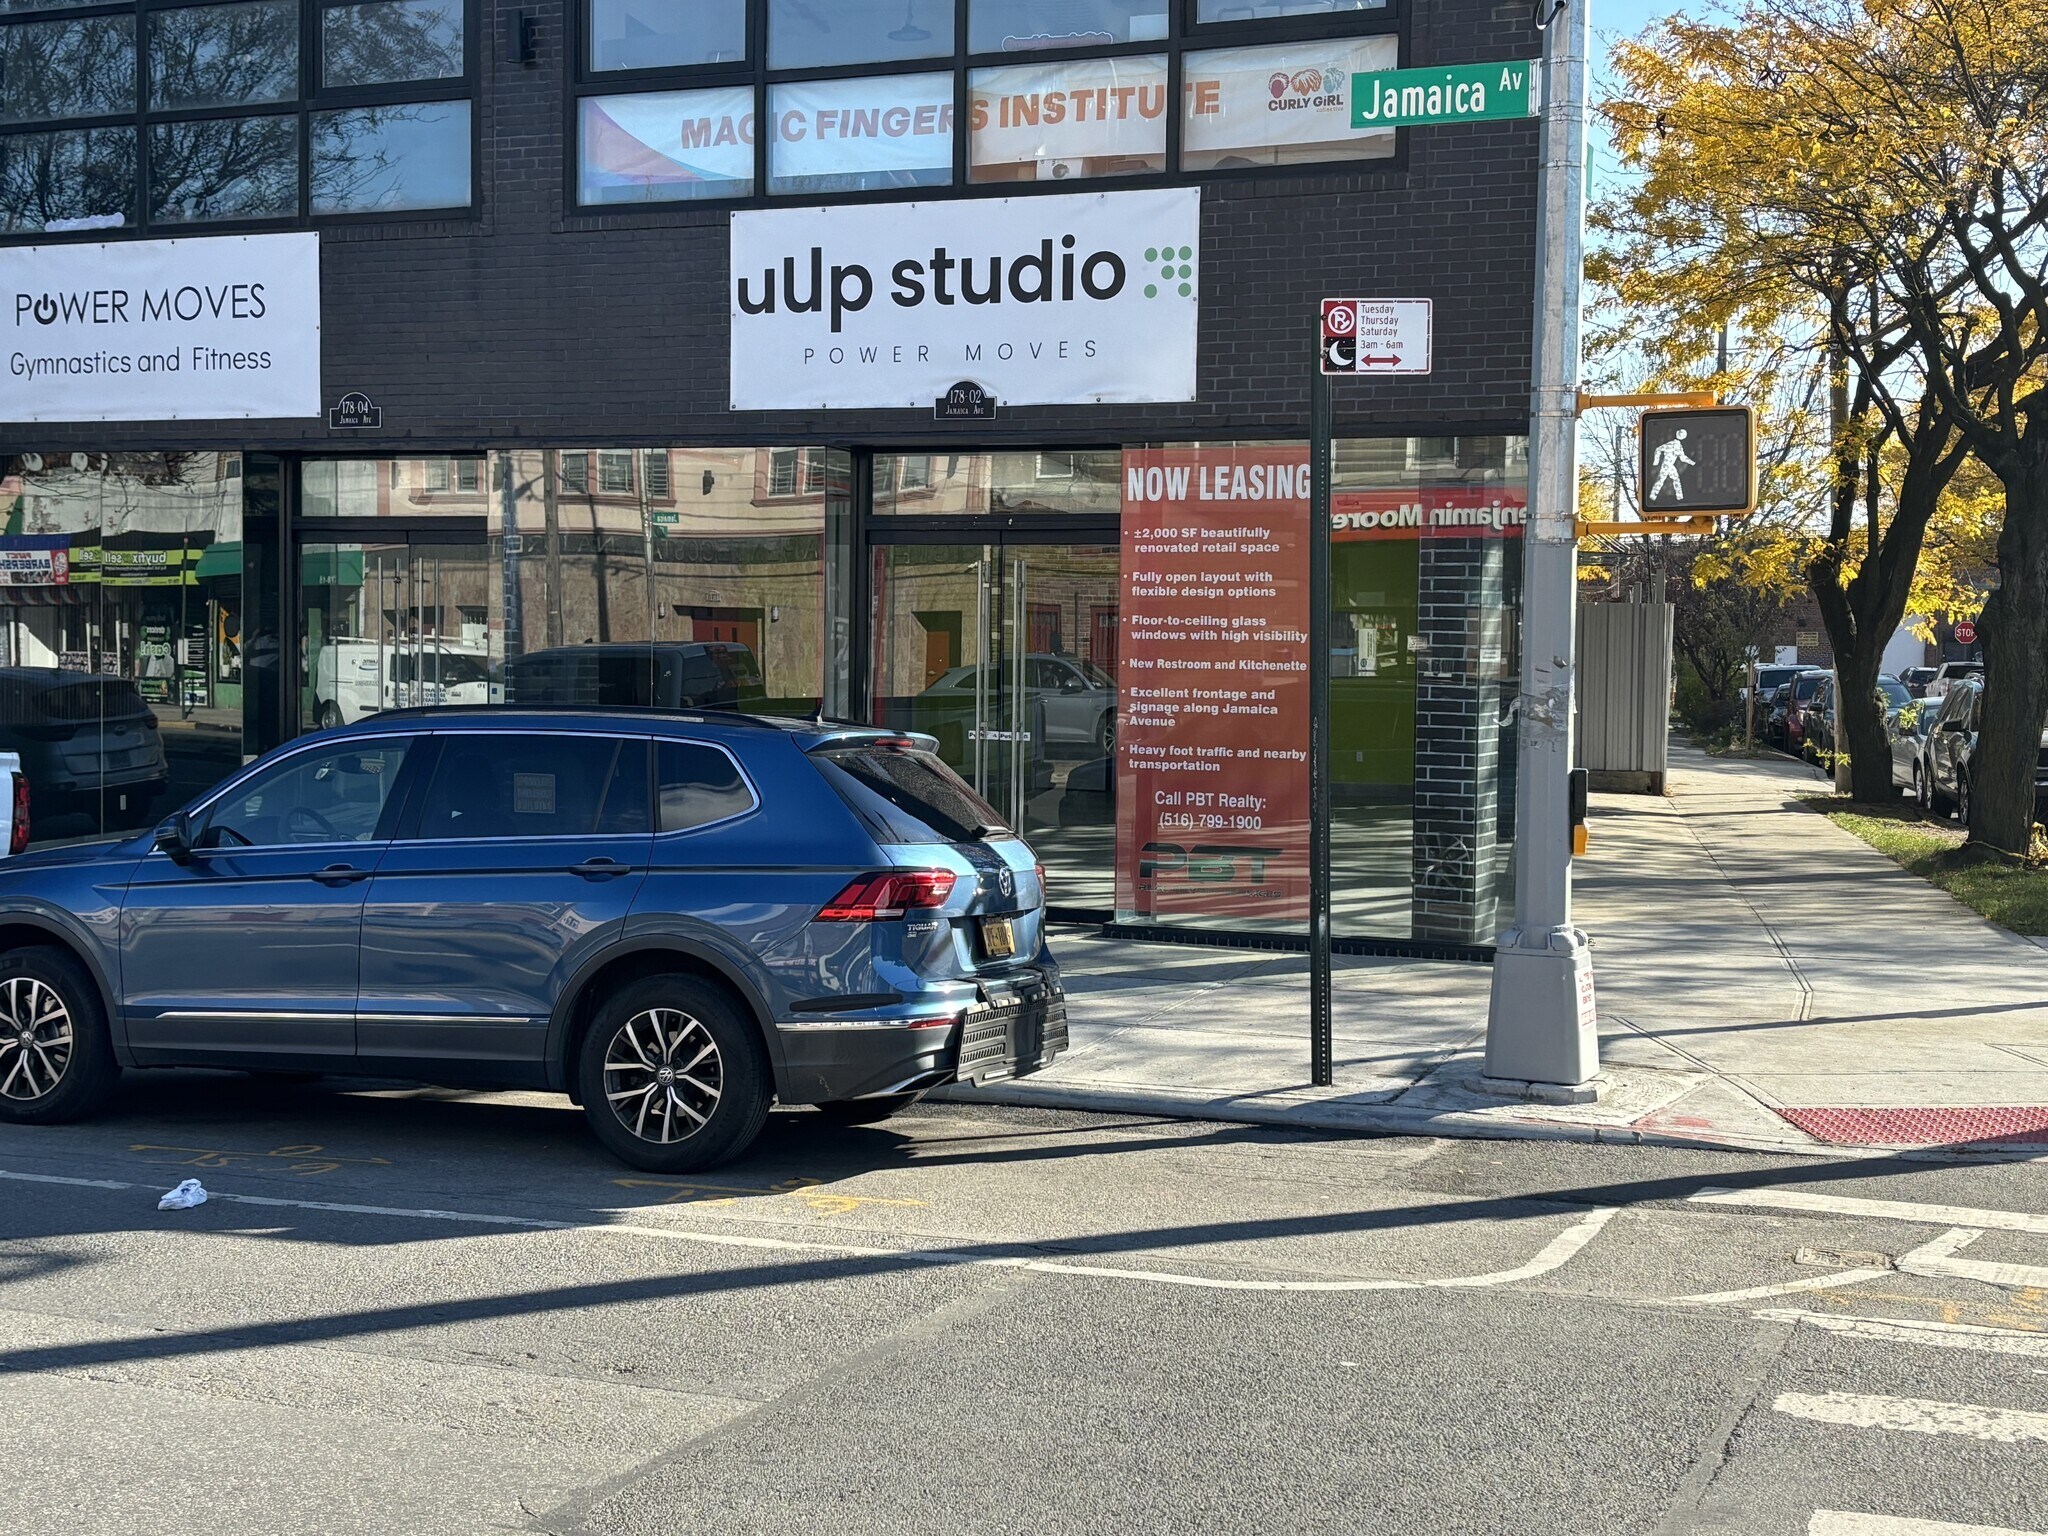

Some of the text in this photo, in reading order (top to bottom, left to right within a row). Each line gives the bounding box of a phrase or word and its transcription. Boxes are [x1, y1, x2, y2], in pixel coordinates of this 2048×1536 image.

[1362, 68, 1523, 121] Jamaica Av
[1268, 97, 1312, 112] CURLY
[737, 234, 1127, 333] uUp studio
[141, 282, 267, 322] MOVES
[1361, 304, 1395, 315] Tuesday
[1361, 316, 1399, 326] Thursday
[1360, 327, 1398, 338] Saturday
[1360, 340, 1378, 349] 3am
[1385, 340, 1404, 349] 6am
[804, 339, 1098, 365] POWER MOVES
[10, 344, 272, 381] Gymnastics and Fitness
[950, 389, 982, 404] 178-02
[342, 401, 369, 414] 178-04
[1127, 464, 1311, 502] NOW LEASING
[1134, 527, 1270, 541] ±2,000 SF beautifully
[1135, 542, 1280, 555] renovated retail space
[1132, 572, 1273, 585] Fully open layout with
[1131, 586, 1277, 599] flexible design options
[1131, 615, 1267, 628] Floor-to-ceiling glass
[1131, 630, 1308, 643] windows with high visibility
[1957, 628, 1975, 637] STOP
[1129, 659, 1307, 671] New Restroom and Kitchenette
[1130, 687, 1276, 701] Excellent frontage and
[1129, 702, 1278, 715] signage along Jamaica
[1129, 716, 1176, 727] Avenue
[1129, 744, 1307, 761] Heavy foot traffic and nearby
[1129, 759, 1221, 772] transportation
[1154, 791, 1267, 812] Call PBT Realty:
[1159, 812, 1262, 830] (516) 799-1900
[1138, 842, 1284, 884] PBT
